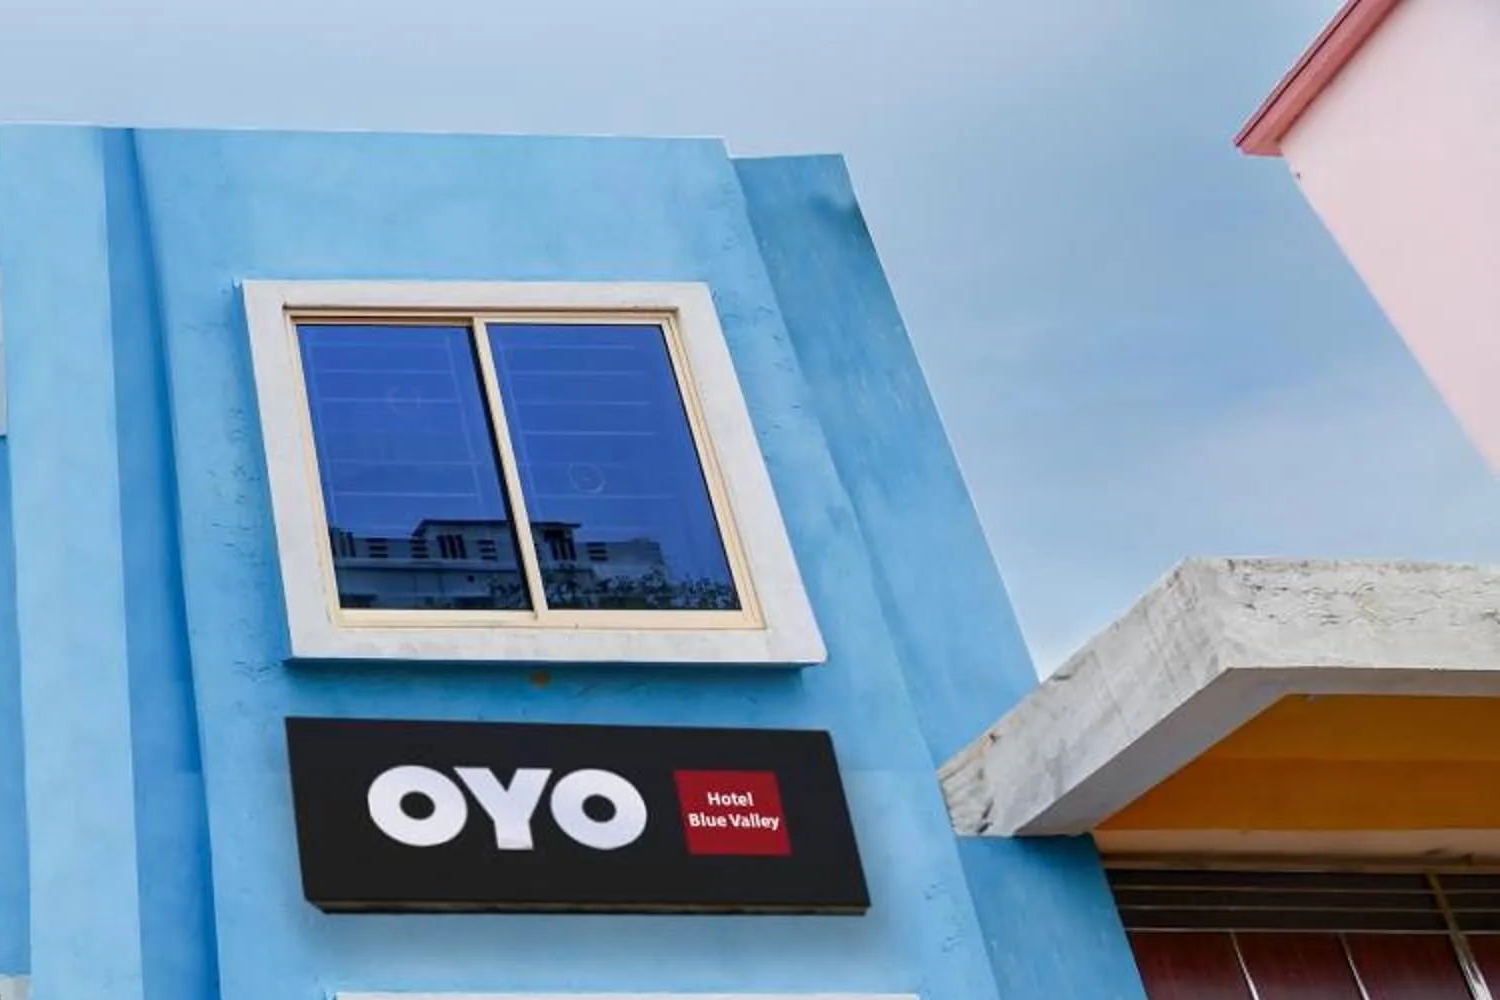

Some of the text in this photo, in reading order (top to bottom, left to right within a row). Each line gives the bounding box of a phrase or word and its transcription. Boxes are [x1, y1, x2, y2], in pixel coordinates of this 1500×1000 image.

[367, 765, 648, 850] OYO
[707, 791, 754, 807] Hotel
[688, 812, 779, 831] Blue Valley
